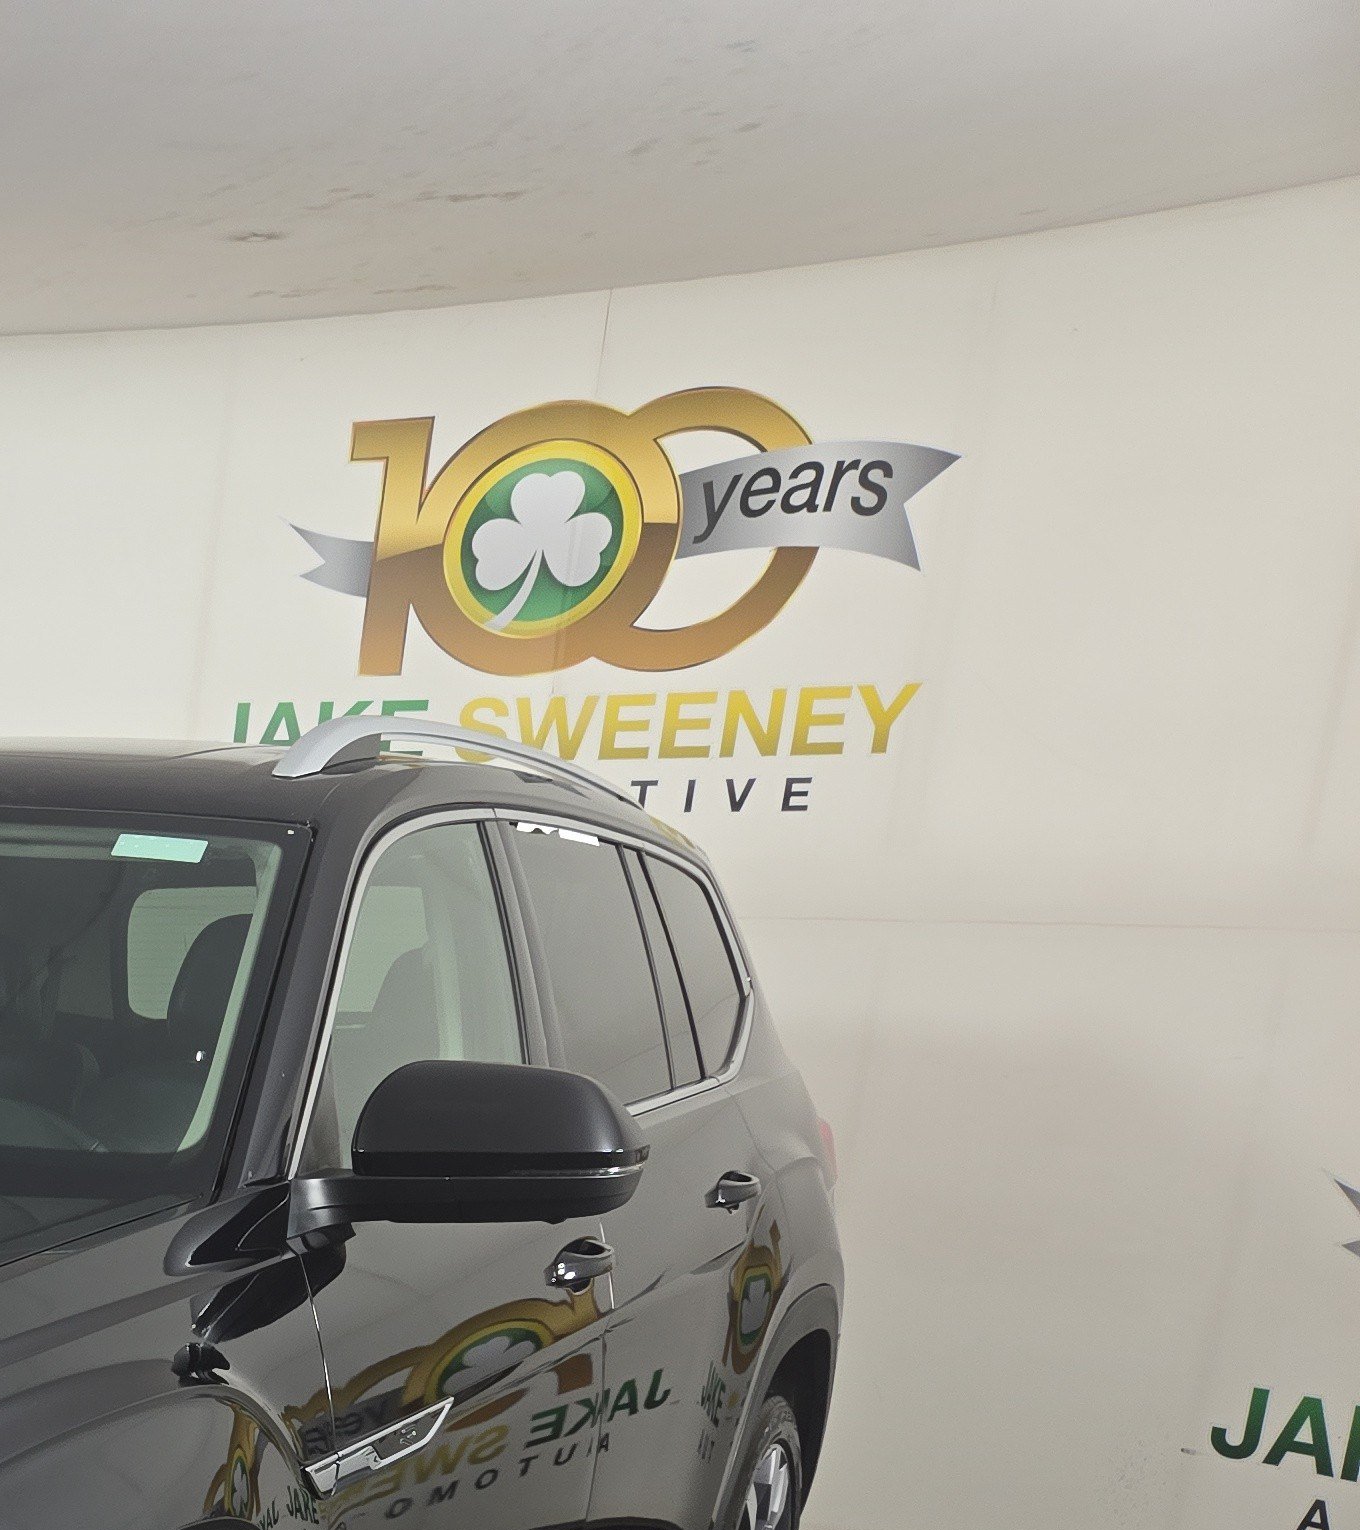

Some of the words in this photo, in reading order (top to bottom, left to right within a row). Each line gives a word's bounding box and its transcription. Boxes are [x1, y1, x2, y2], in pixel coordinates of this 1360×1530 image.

[692, 455, 894, 545] years
[453, 682, 922, 763] SWEENEY
[630, 777, 813, 813] TIVE
